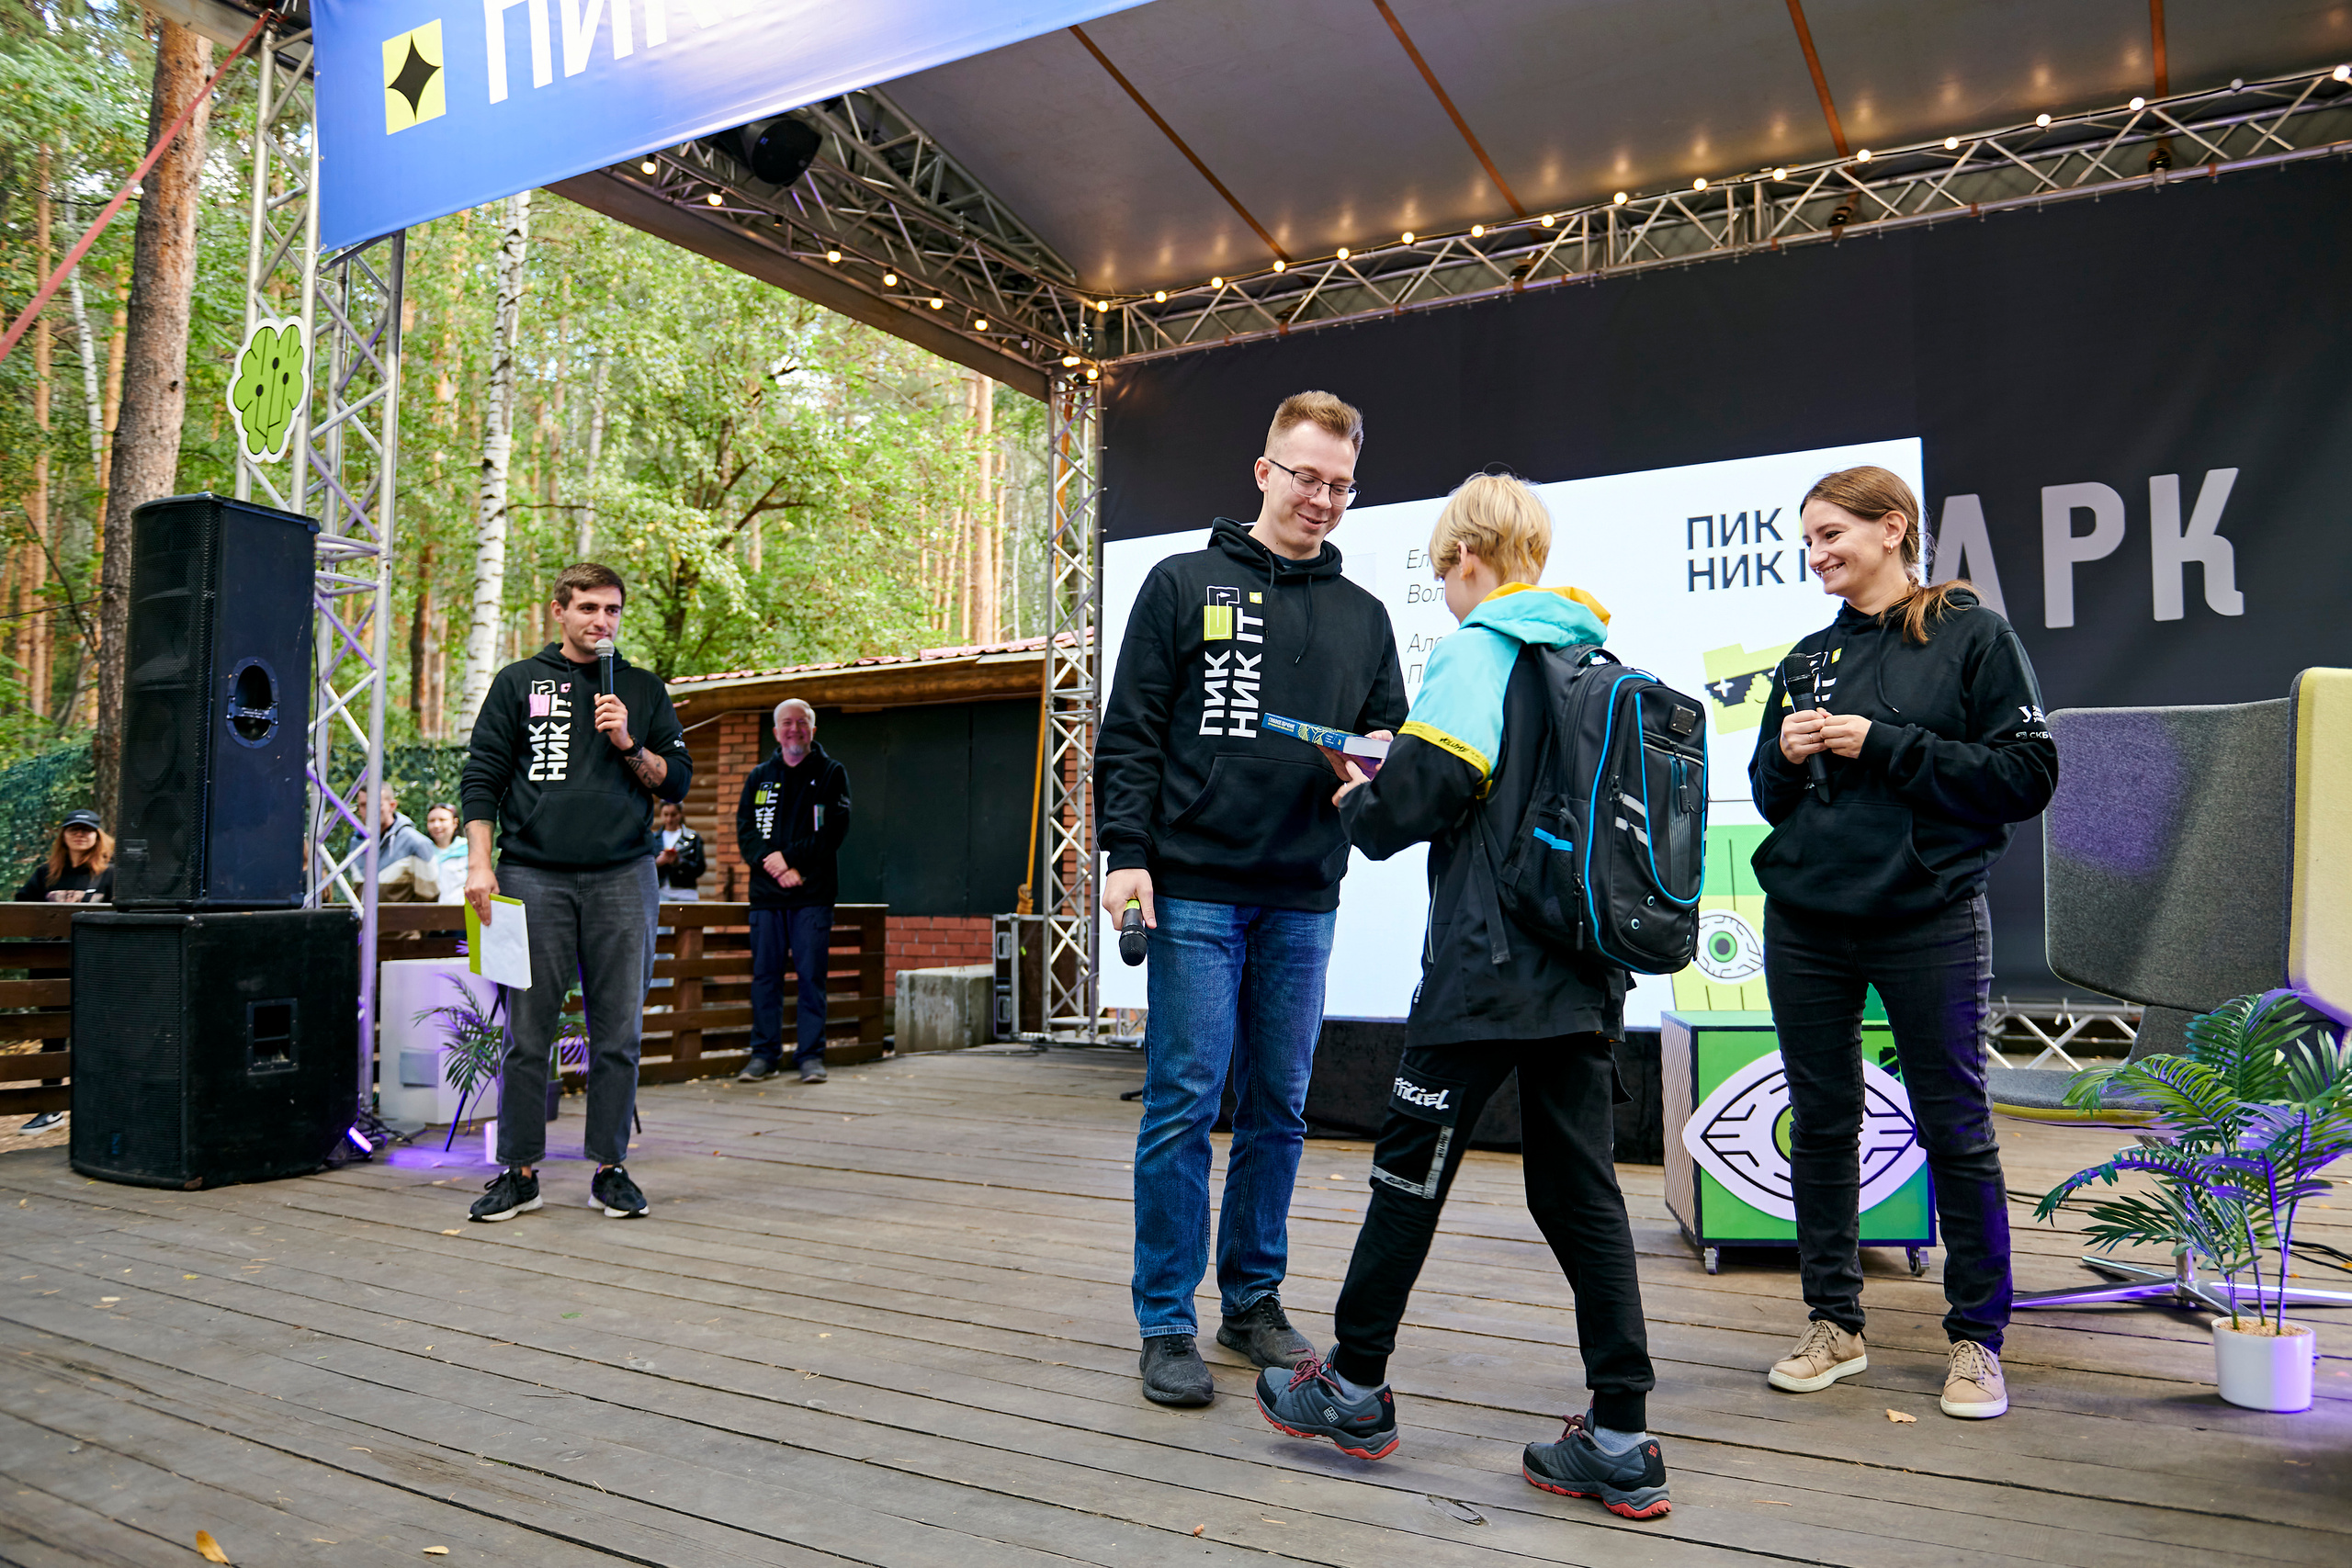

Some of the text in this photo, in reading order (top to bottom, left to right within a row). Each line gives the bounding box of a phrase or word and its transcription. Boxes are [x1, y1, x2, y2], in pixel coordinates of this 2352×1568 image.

[1687, 507, 1784, 550] ПИК
[1688, 550, 1785, 592] НИК
[1199, 649, 1230, 736] ПИК
[1228, 607, 1264, 739] НИК IT
[528, 721, 548, 781] ПИК
[546, 721, 571, 781] НИК
